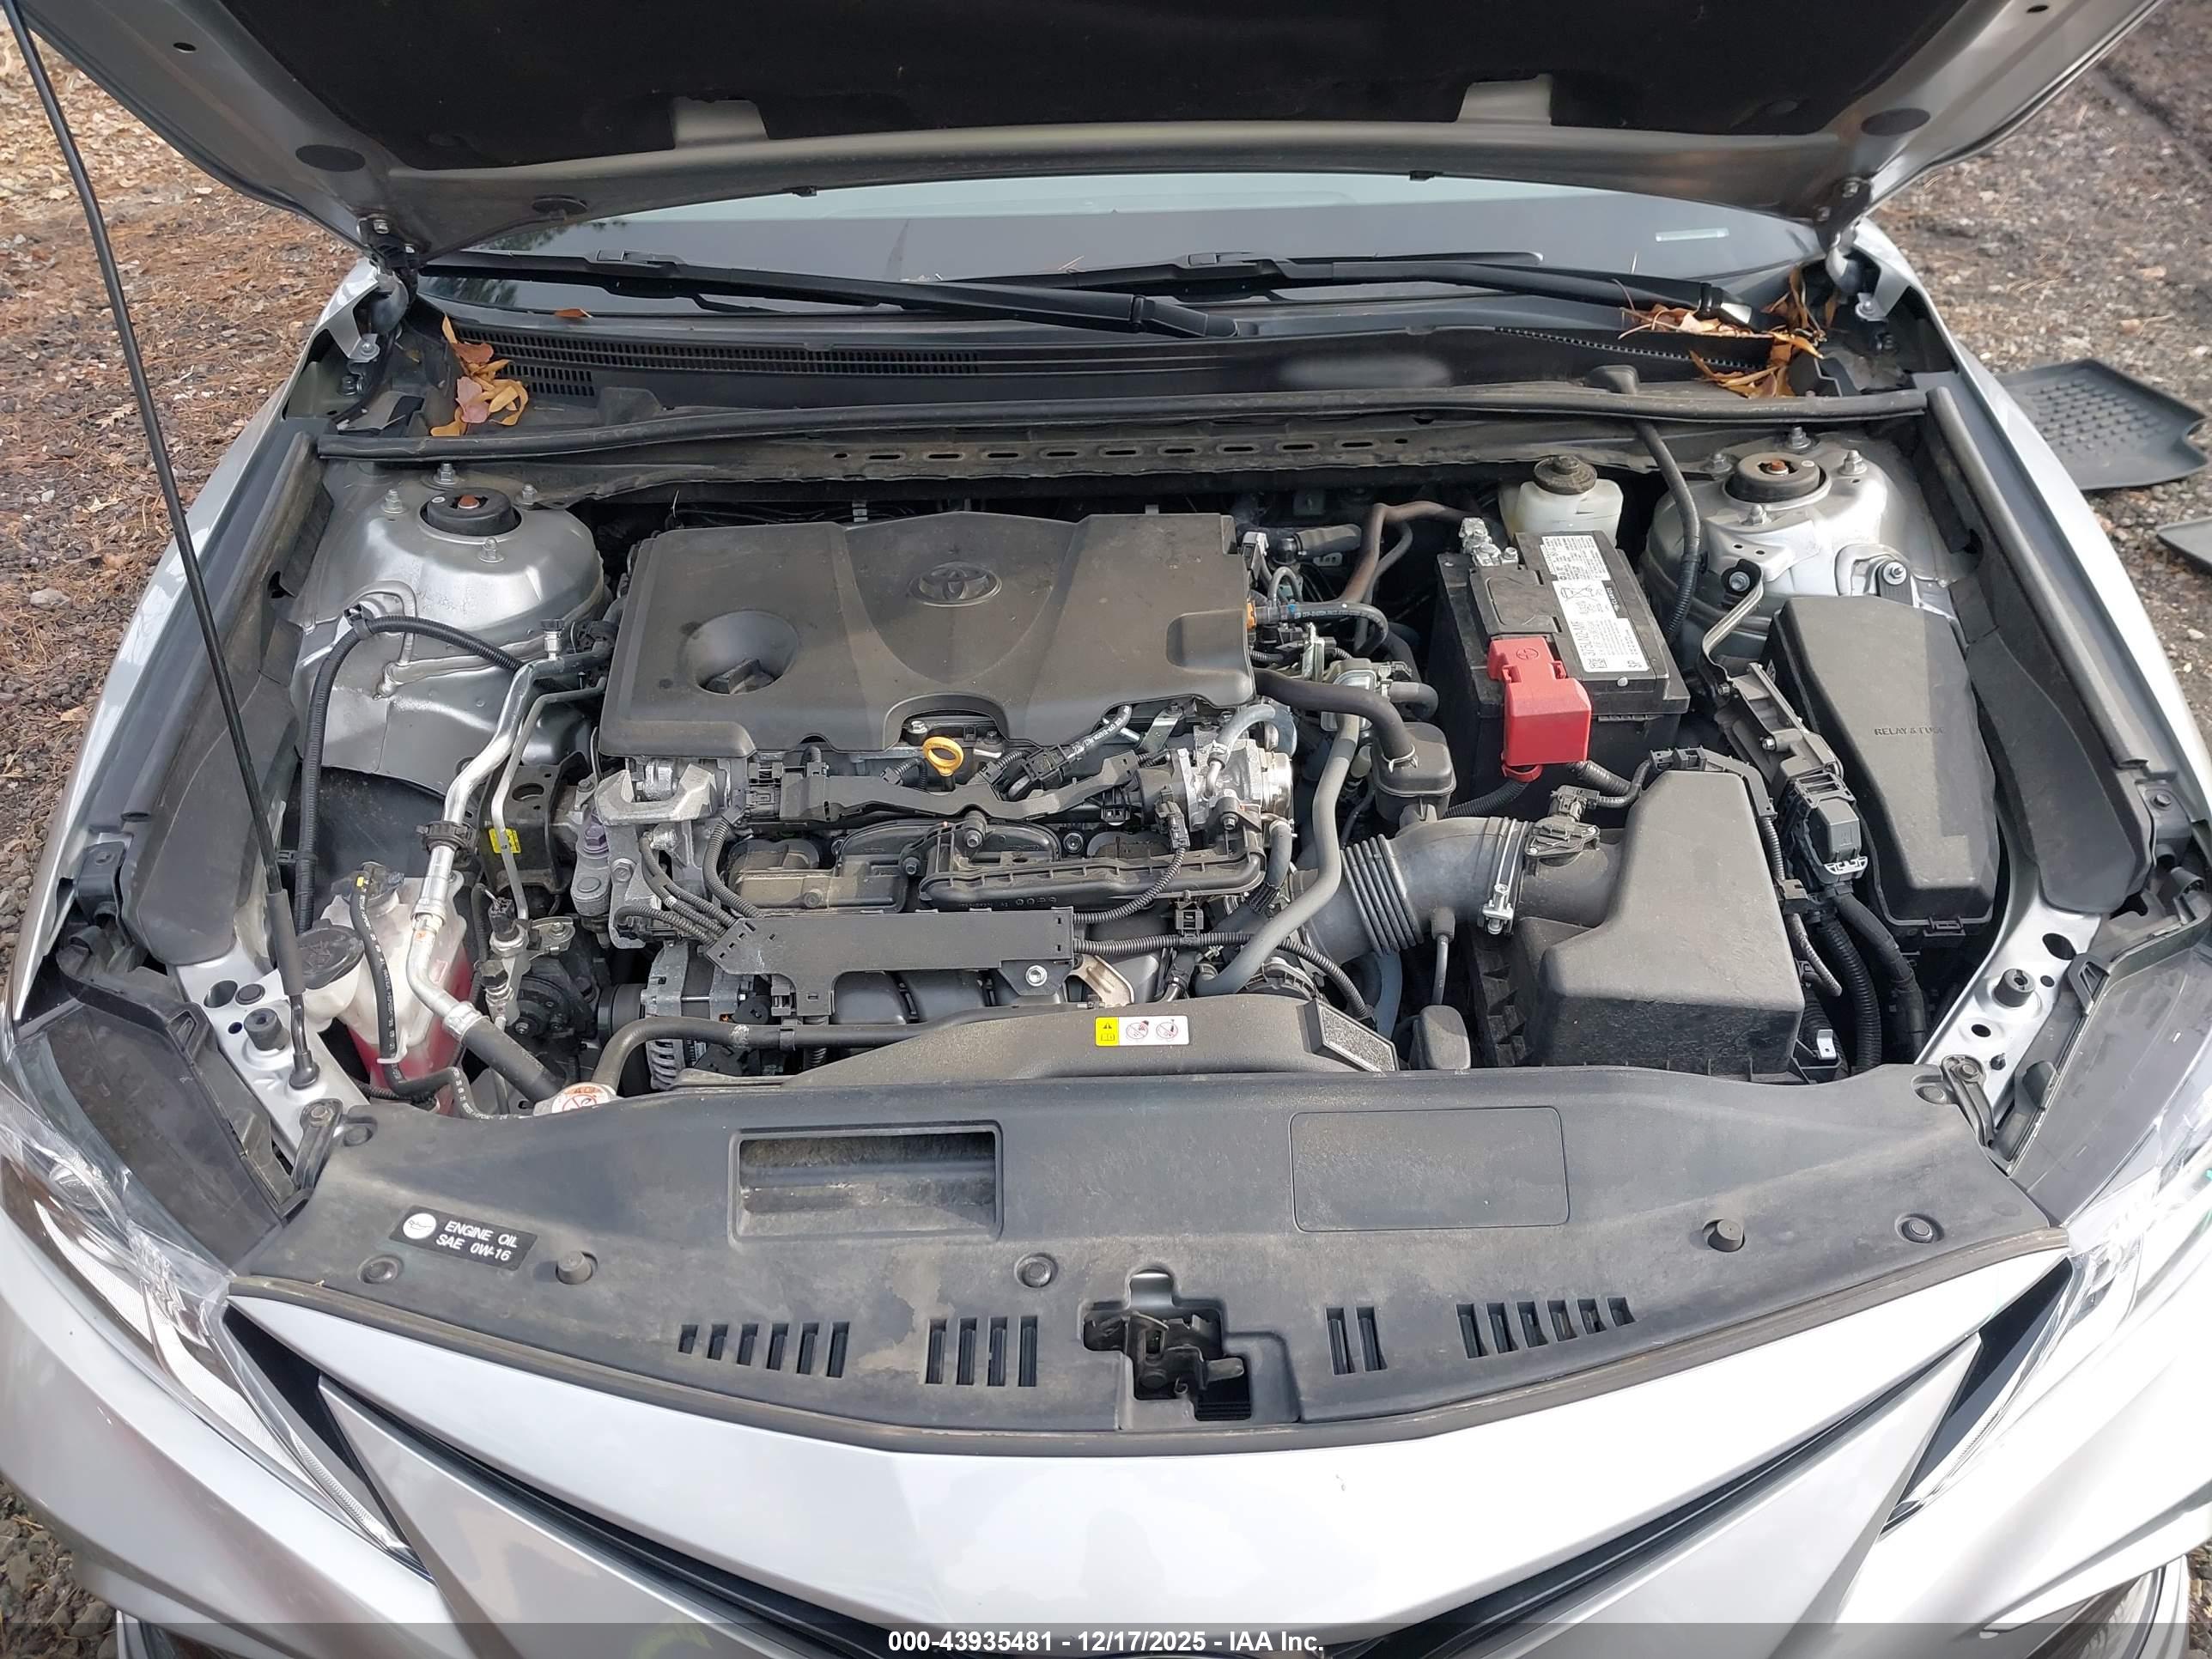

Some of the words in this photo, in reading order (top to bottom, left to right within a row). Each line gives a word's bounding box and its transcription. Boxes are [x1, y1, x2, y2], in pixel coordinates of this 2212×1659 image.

[435, 1234, 465, 1250] SAE
[470, 1243, 512, 1261] 0W-16
[445, 1220, 494, 1241] ENGINE
[497, 1233, 518, 1249] OIL
